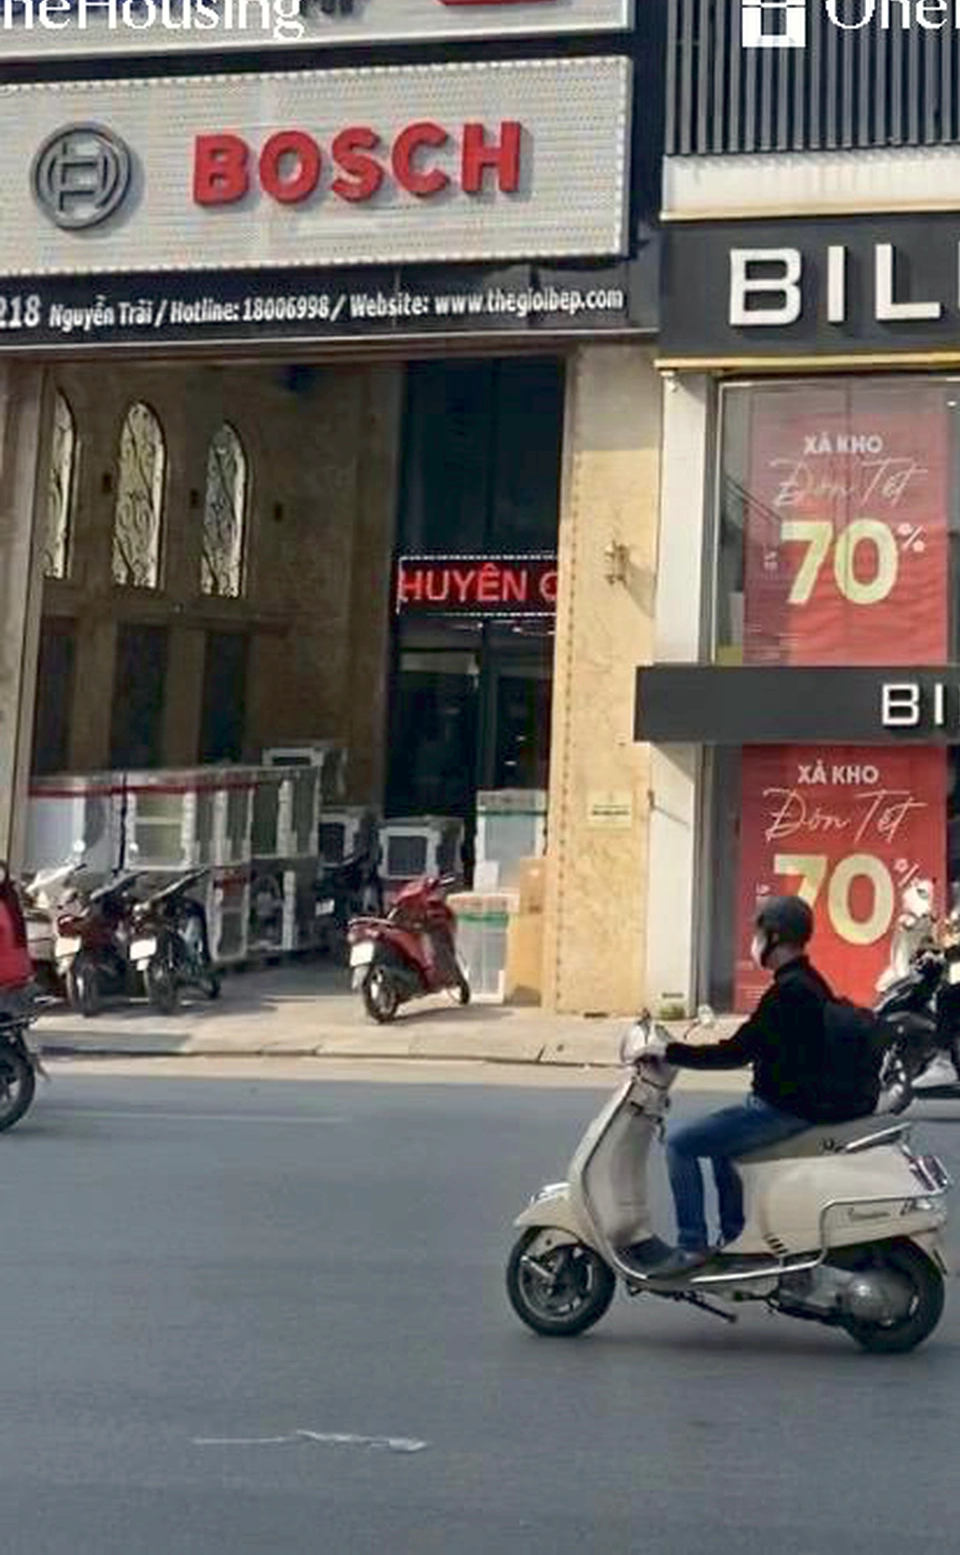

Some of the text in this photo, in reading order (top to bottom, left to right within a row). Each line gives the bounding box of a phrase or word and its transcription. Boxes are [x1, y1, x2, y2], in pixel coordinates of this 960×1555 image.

[193, 121, 520, 206] BOSCH
[171, 299, 239, 323] Hotline:
[350, 291, 429, 319] Website:
[434, 287, 624, 316] www.thegioibep.com
[837, 435, 883, 454] KHO
[798, 759, 879, 784] XẢ KHO
[853, 789, 928, 844] Tết
